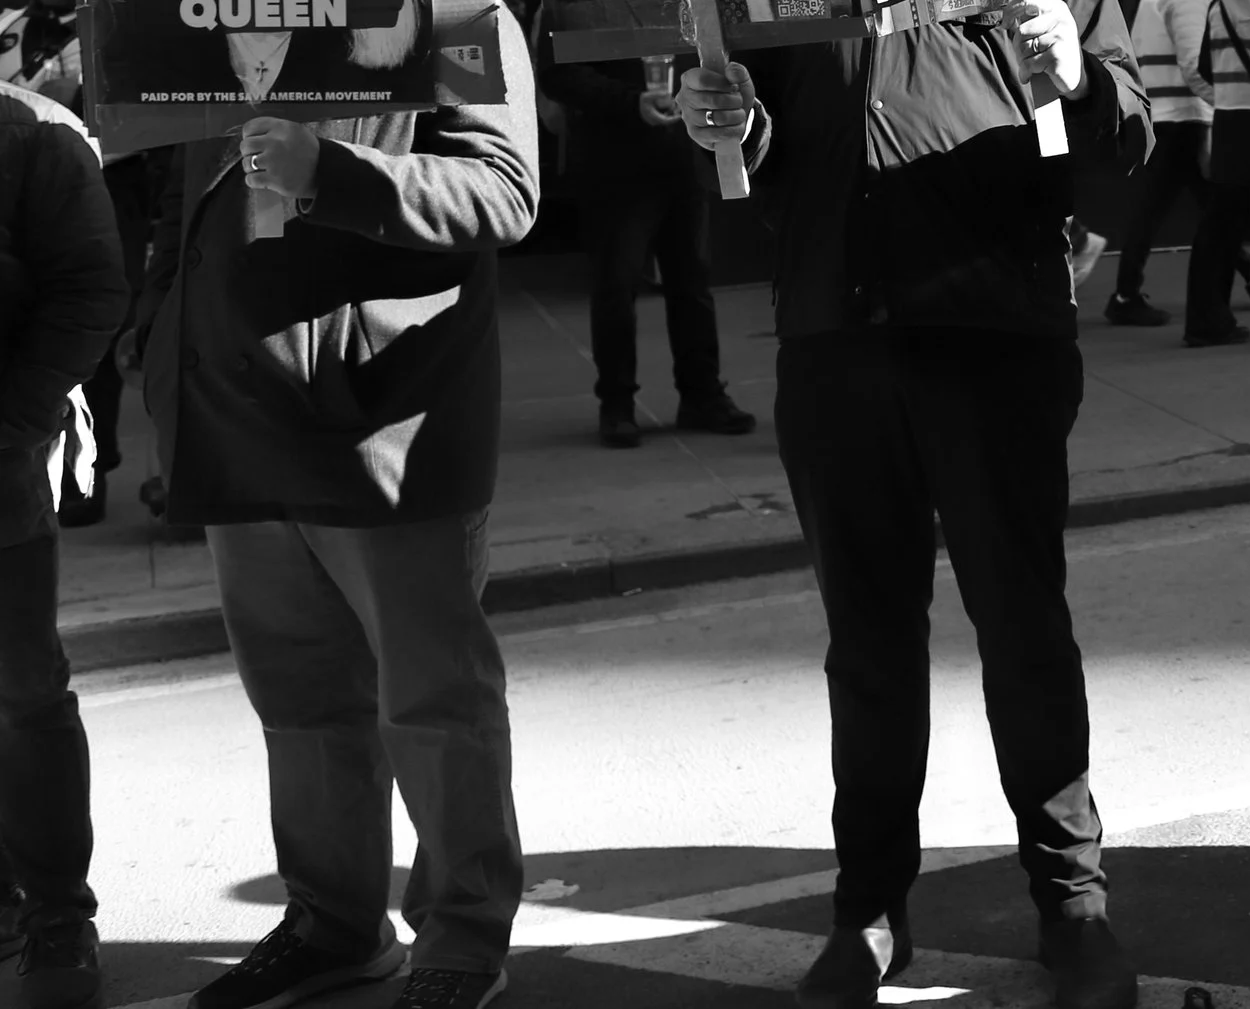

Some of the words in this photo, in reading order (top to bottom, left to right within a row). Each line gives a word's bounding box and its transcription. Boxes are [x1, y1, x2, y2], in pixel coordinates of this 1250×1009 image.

[141, 92, 169, 102] PAID
[171, 92, 194, 102] FOR
[197, 92, 212, 102] BY
[213, 92, 236, 102] THE
[238, 92, 267, 102] SAVE
[269, 92, 323, 101] AMERICA
[325, 91, 392, 101] MOVEMENT
